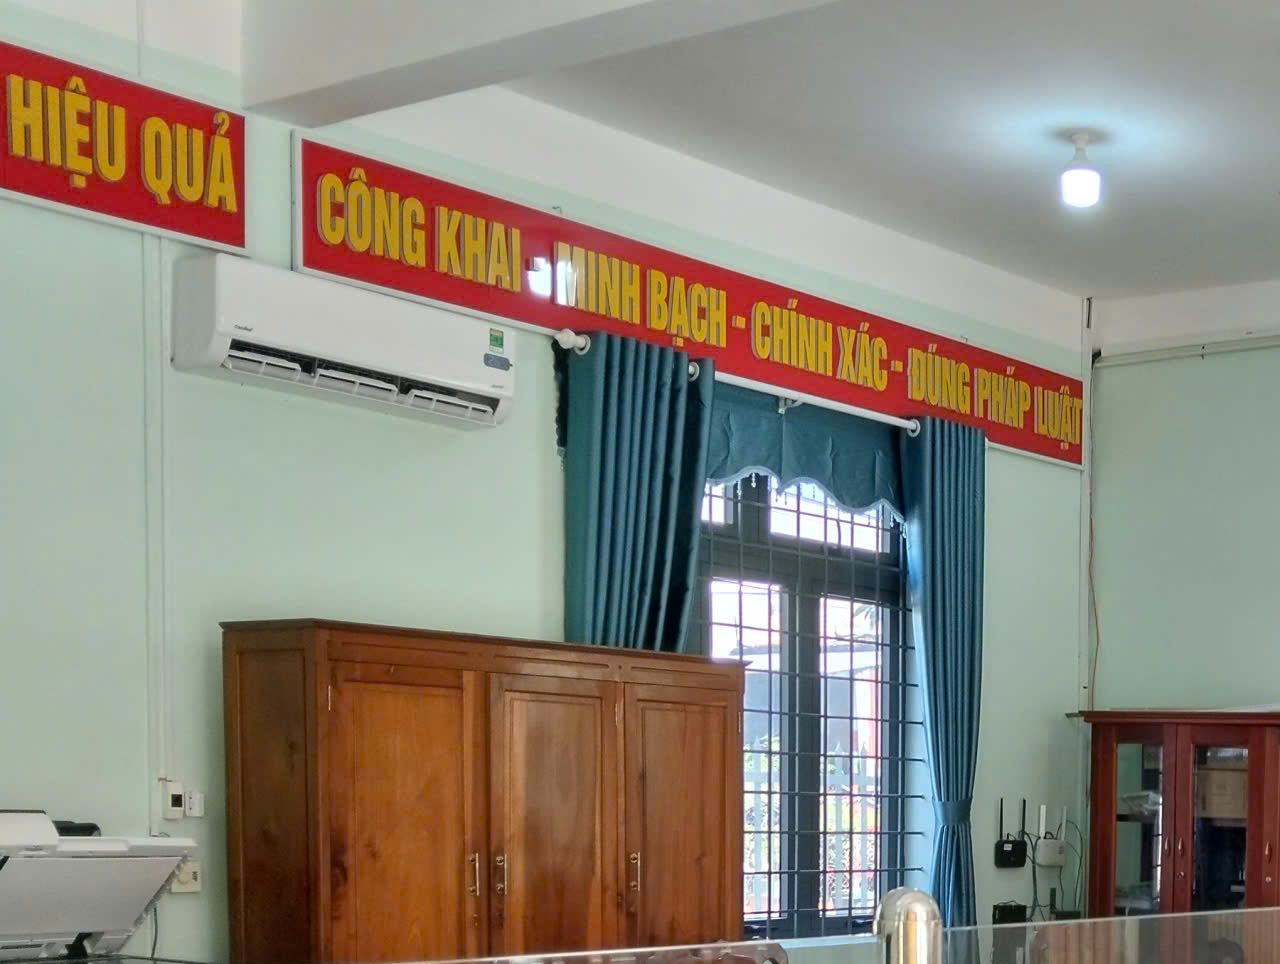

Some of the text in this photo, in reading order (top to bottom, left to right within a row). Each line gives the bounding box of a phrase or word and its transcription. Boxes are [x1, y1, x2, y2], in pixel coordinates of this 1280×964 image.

[7, 74, 237, 213] HIỆU QUẢ
[316, 167, 426, 268] CÔNG
[434, 205, 521, 292] KHAI
[553, 241, 640, 325] MINH
[646, 268, 726, 347] BẠCH
[751, 299, 833, 376] CHÍNH
[836, 321, 888, 391] XÁC
[907, 344, 971, 414] ĐÚNG
[974, 366, 1031, 429] PHÁP
[1034, 385, 1083, 450] LUẬT
